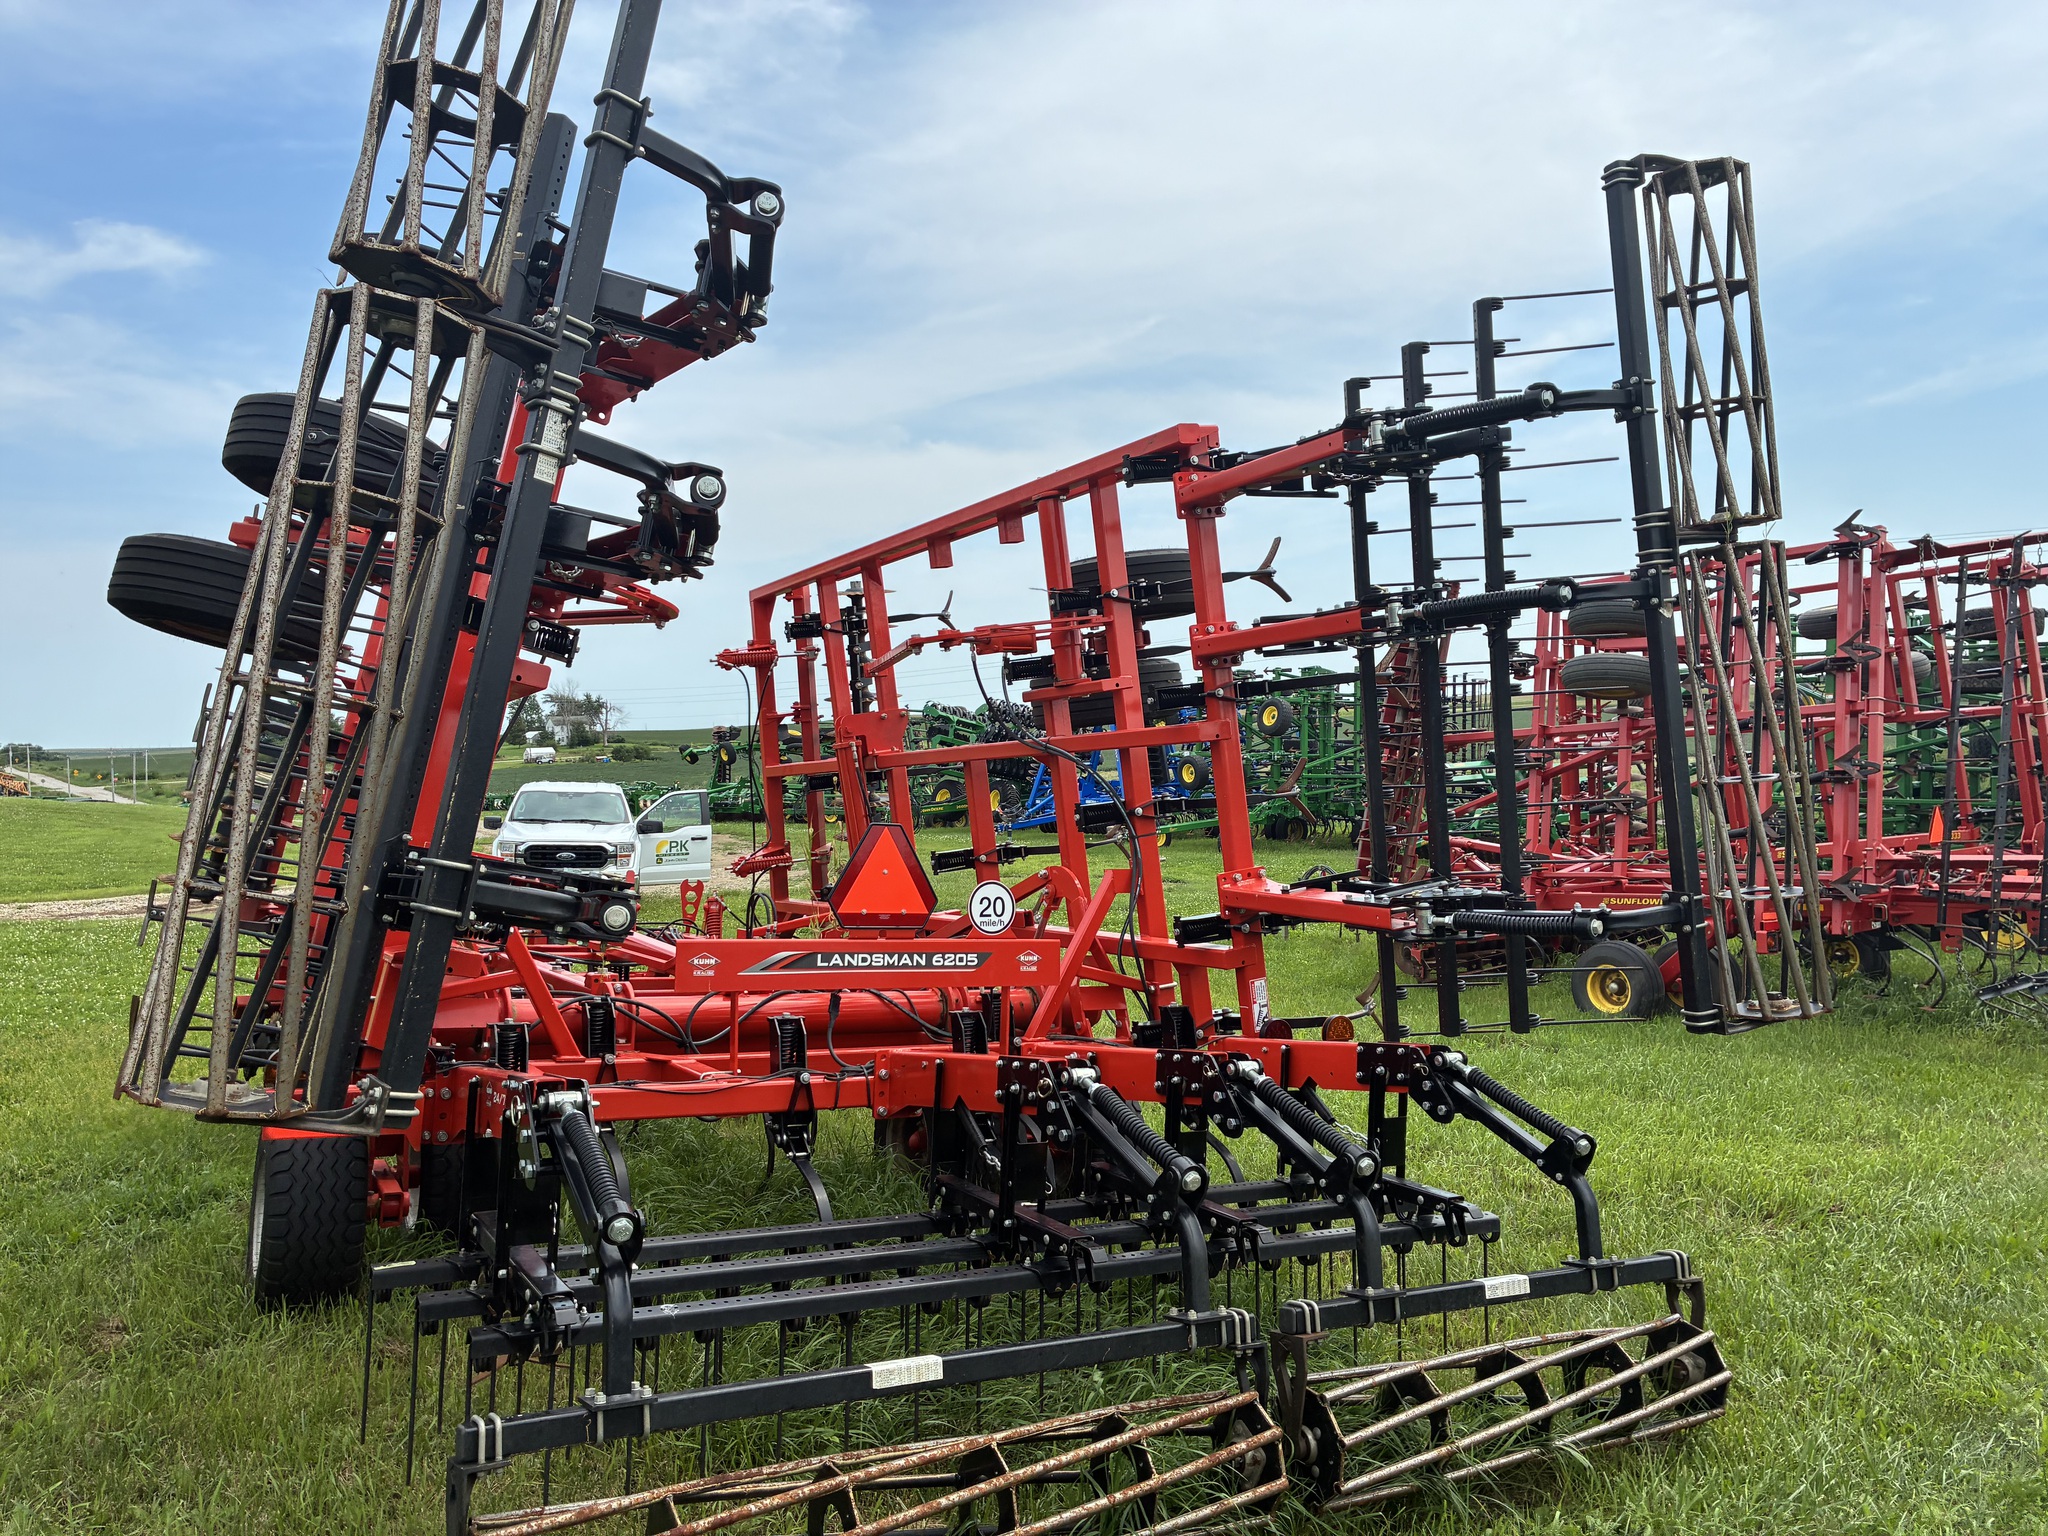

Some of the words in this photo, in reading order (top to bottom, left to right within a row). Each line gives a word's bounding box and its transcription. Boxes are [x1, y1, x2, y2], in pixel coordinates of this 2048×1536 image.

[979, 896, 1006, 918] 20
[980, 919, 1005, 927] mile/h
[816, 953, 926, 967] LANDSMAN
[932, 953, 979, 966] 6205
